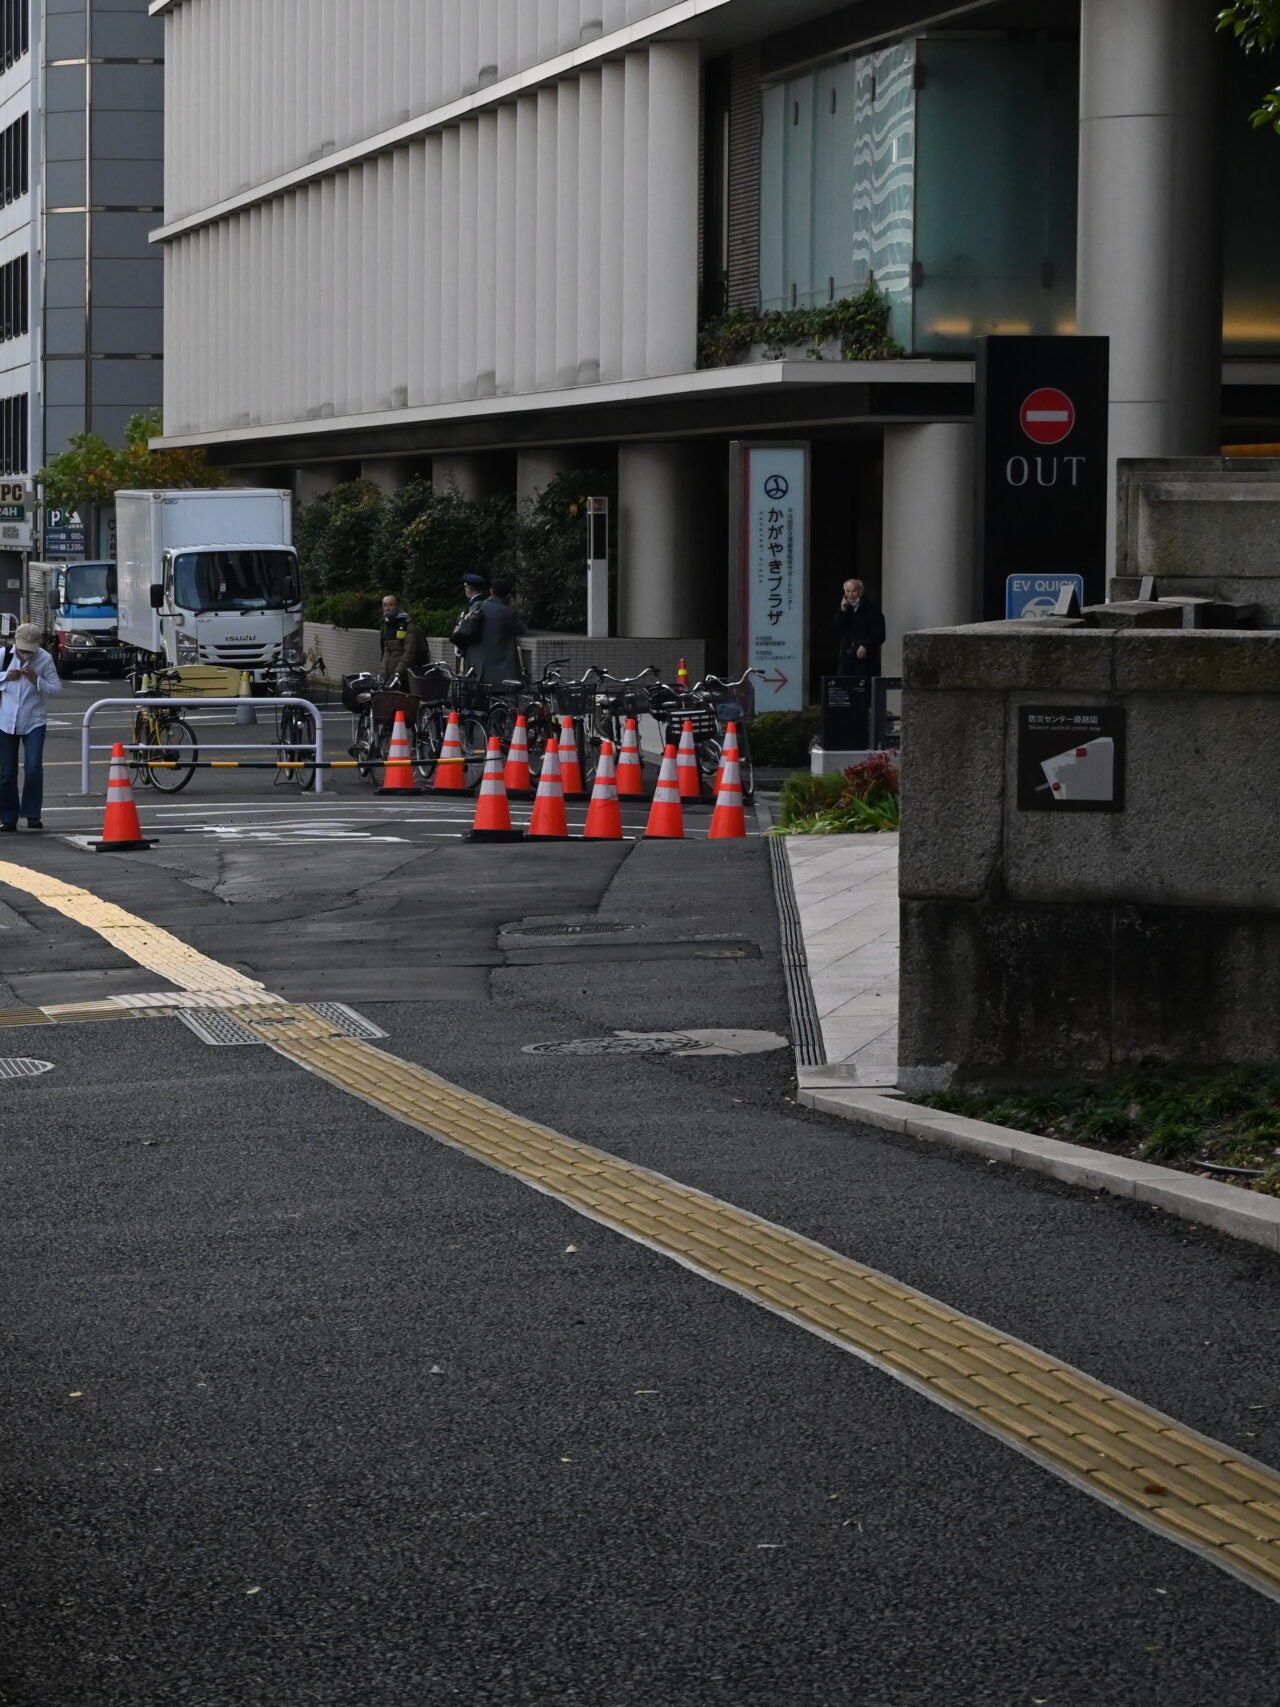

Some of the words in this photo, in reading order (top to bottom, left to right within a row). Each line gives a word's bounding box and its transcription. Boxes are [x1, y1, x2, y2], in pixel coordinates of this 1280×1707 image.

[1006, 455, 1086, 486] OUT
[51, 510, 61, 526] P
[767, 507, 784, 627] かがやきプラザ
[1013, 580, 1032, 592] EV
[224, 632, 256, 642] ISUZU
[1028, 714, 1098, 724] 防災センター経路図
